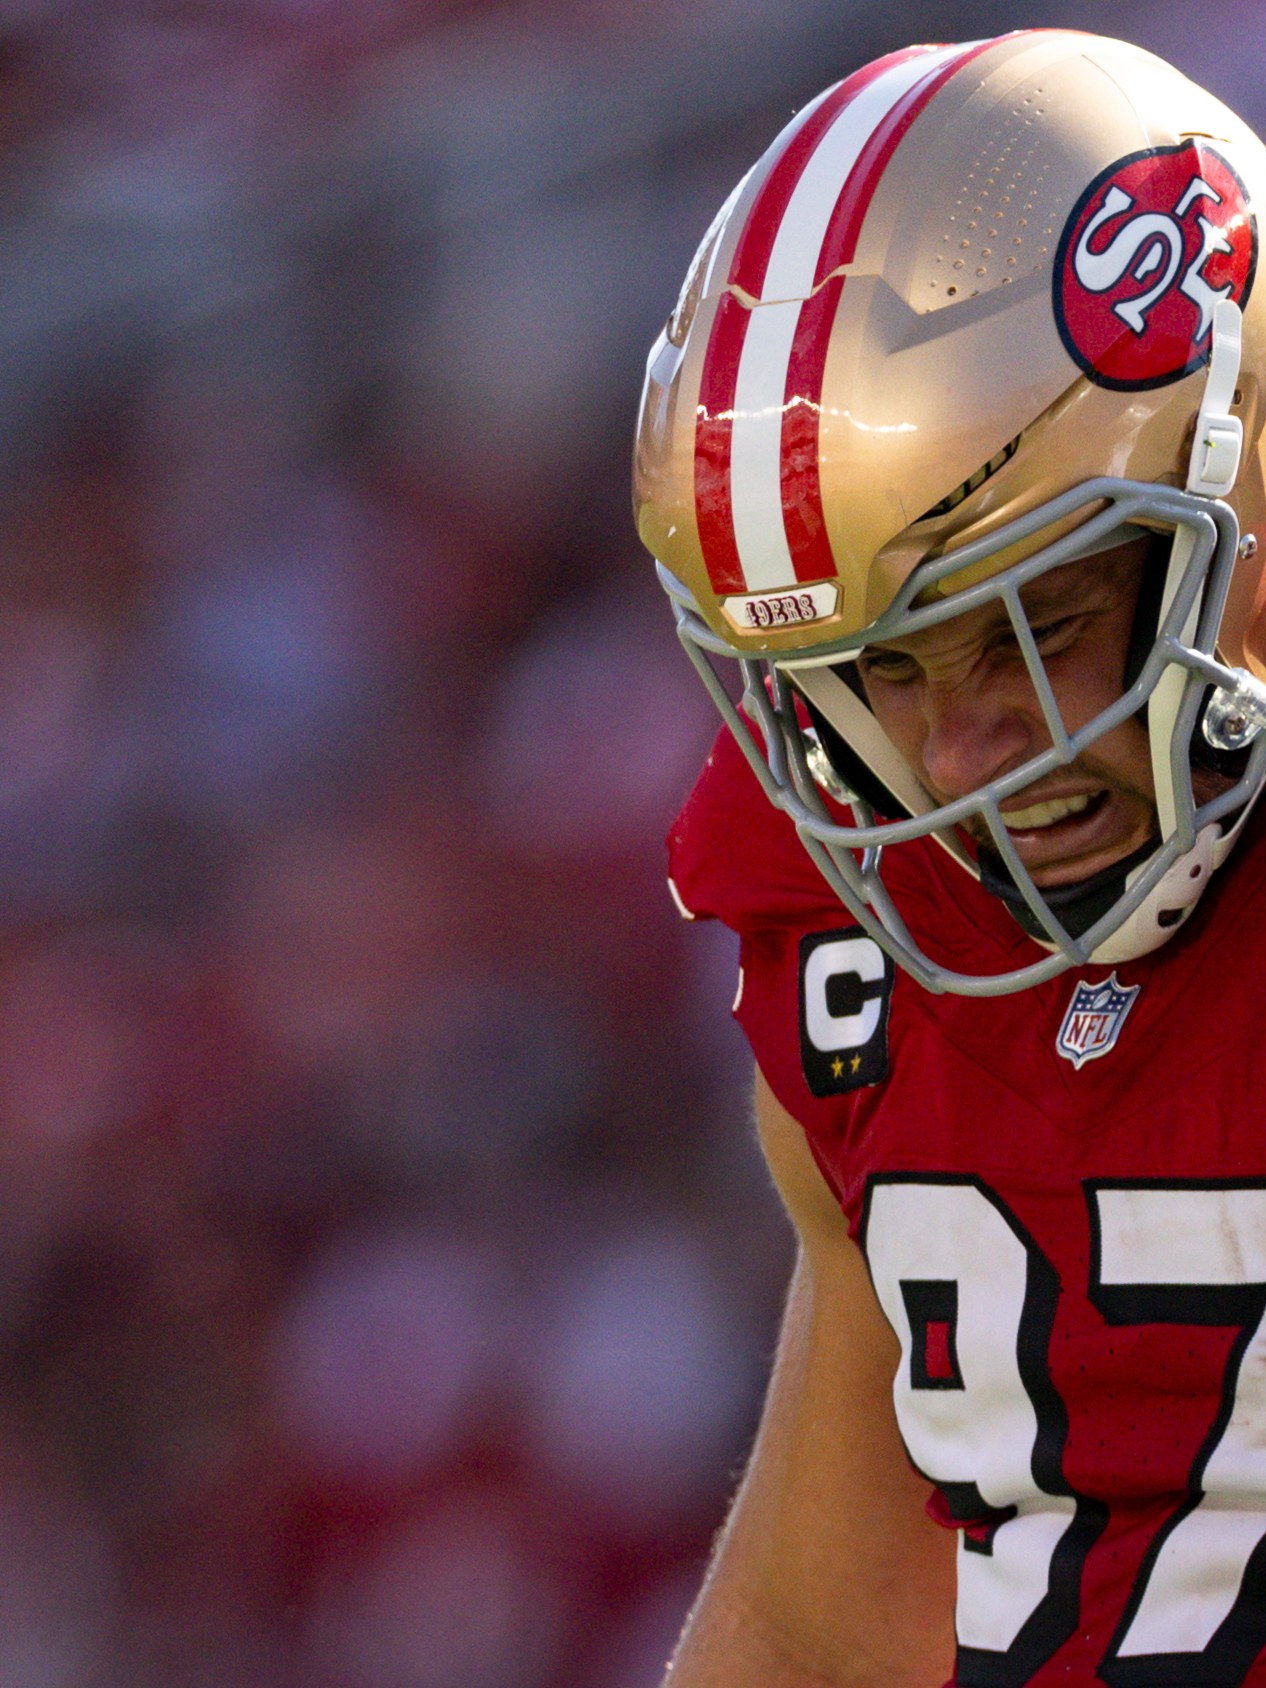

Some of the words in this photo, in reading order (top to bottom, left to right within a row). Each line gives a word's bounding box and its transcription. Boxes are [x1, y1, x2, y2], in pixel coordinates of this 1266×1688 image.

[745, 594, 817, 627] 49ERS
[804, 937, 886, 1052] C
[1065, 1013, 1110, 1049] NFL
